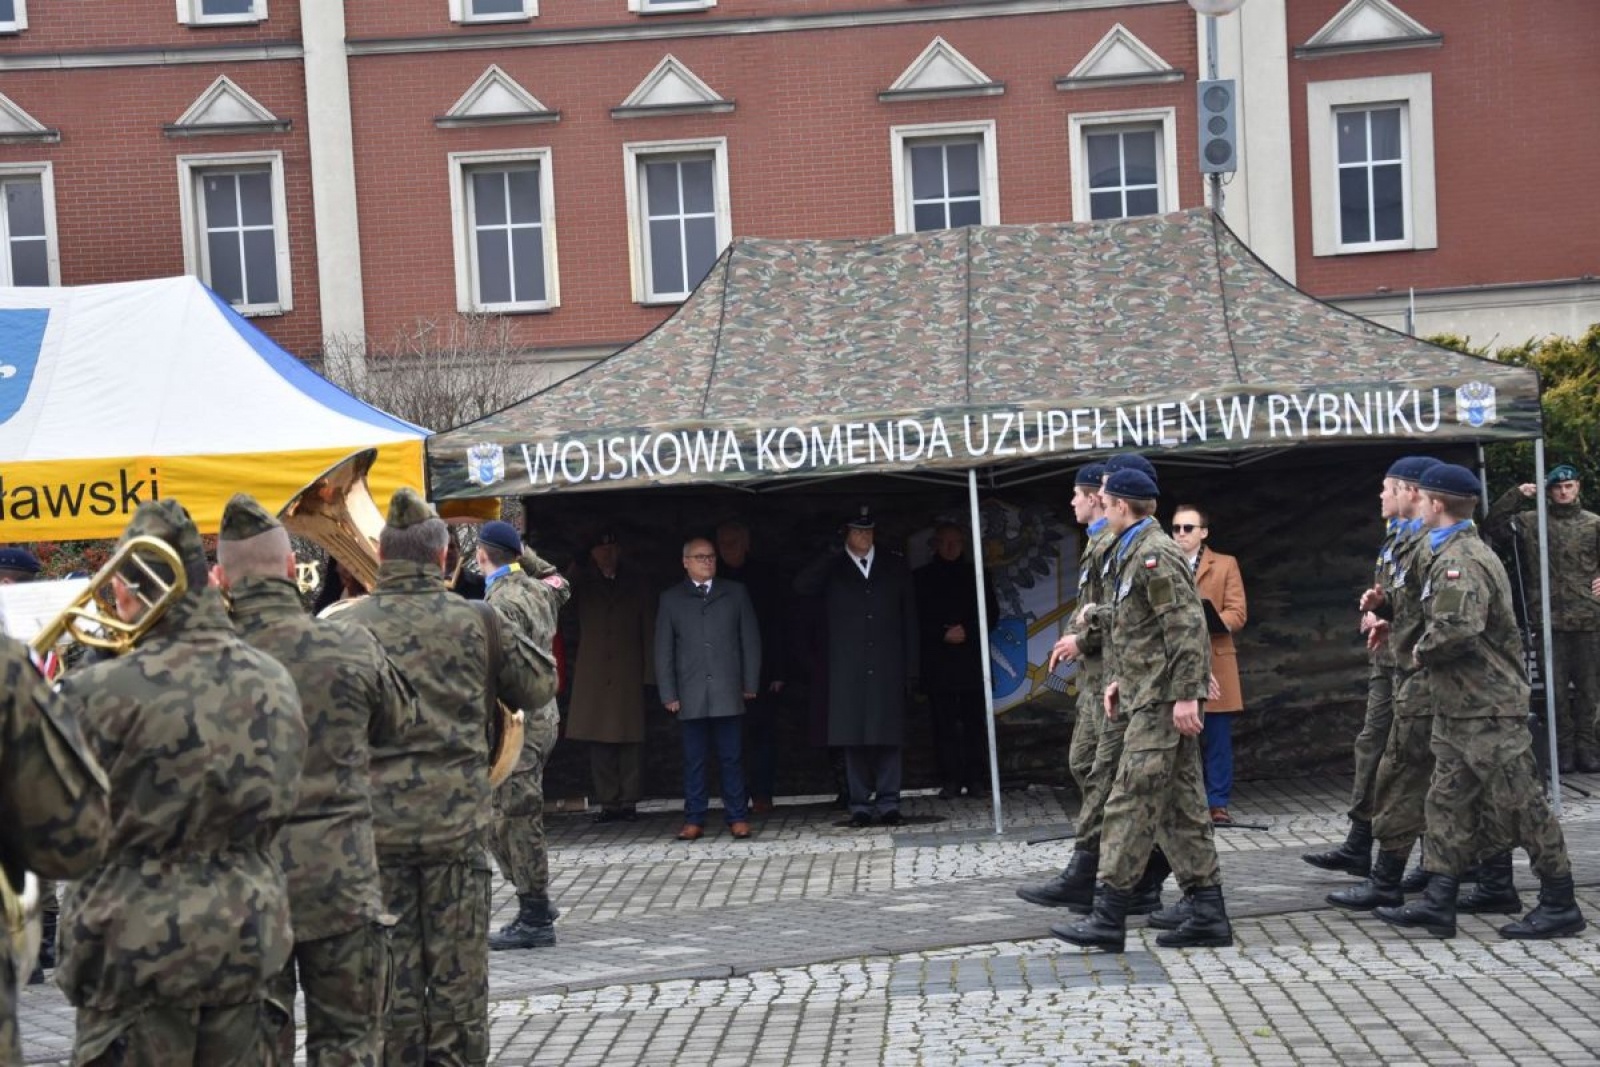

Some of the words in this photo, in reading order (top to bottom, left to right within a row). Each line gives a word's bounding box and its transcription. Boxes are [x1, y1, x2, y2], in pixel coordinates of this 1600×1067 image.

[520, 428, 745, 485] WOJSKOWA
[755, 416, 953, 470] KOMENDA
[963, 394, 1207, 456] UZUPEŁNIEŃ
[1215, 395, 1255, 440] W
[1268, 388, 1441, 438] RYBNIKU
